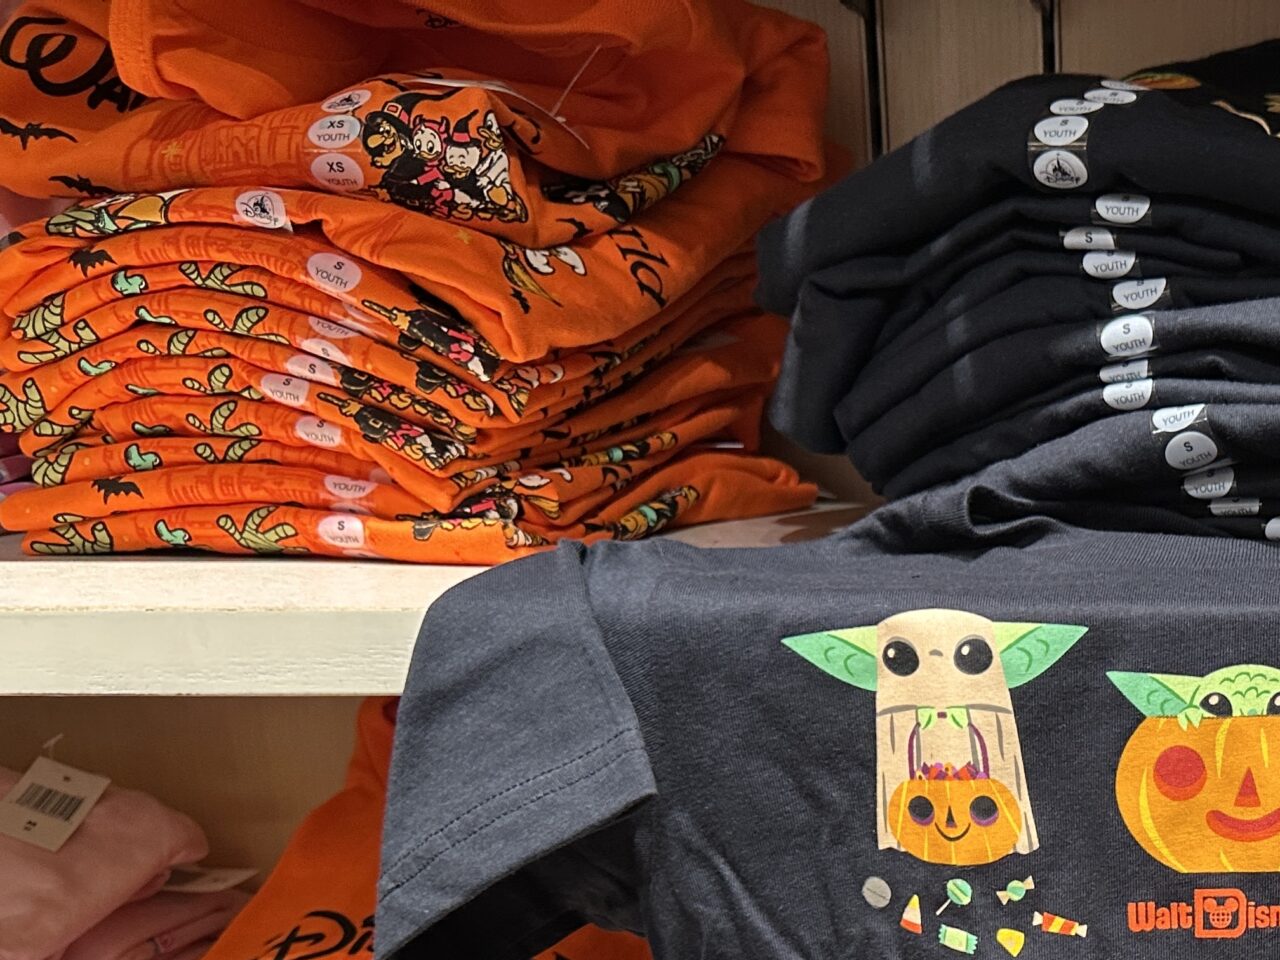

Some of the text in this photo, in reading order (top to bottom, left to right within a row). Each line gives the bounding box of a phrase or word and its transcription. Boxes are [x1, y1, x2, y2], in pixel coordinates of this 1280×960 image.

[327, 120, 345, 129] XS
[316, 132, 350, 142] YOUTH
[1043, 129, 1077, 138] YOUTH
[326, 162, 345, 173] XS
[325, 178, 358, 187] YOUTH
[1105, 205, 1140, 216] YOUTH
[1085, 232, 1093, 243] S
[333, 261, 345, 270] S
[1093, 260, 1127, 273] YOUTH
[314, 267, 348, 289] YOUTH
[1123, 287, 1158, 303] YOUTH
[1122, 323, 1131, 335] S
[1113, 338, 1146, 353] YOUTH
[308, 363, 317, 374] S
[269, 388, 300, 402] YOUTH
[1113, 392, 1145, 406] YOUTH
[1162, 409, 1194, 426] YOUTH
[304, 430, 335, 443] YOUTH
[1183, 441, 1193, 452] S
[1179, 451, 1213, 467] YOUTH
[332, 481, 366, 493] YOUTH
[1193, 482, 1226, 494] YOUTH
[337, 520, 345, 531] S
[1128, 901, 1193, 933] Walt
